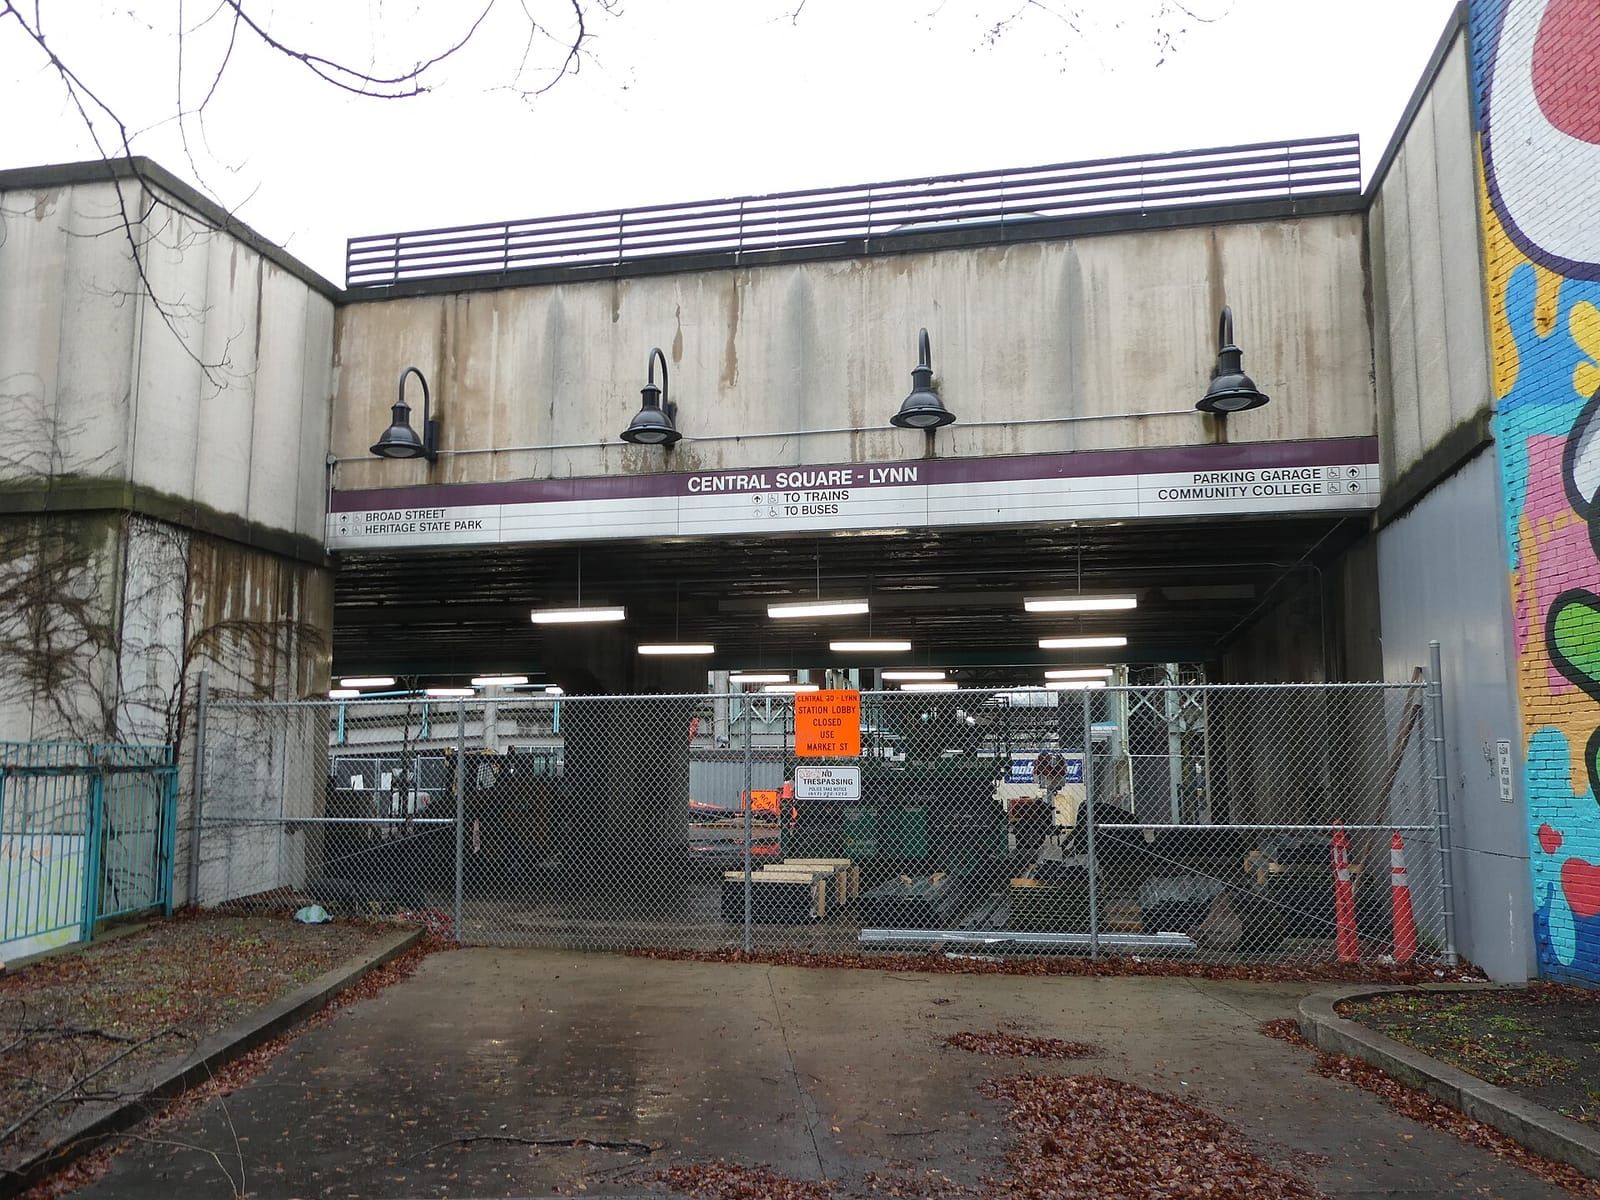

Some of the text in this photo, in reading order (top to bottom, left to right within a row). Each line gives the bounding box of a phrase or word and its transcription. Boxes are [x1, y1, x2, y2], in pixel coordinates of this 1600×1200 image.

[687, 473, 771, 492] CENTRAL
[775, 470, 853, 488] SQUARE
[869, 467, 918, 484] LYNN
[1193, 468, 1321, 484] PARKING GARAGE
[783, 490, 850, 503] TO TRAINS
[1158, 483, 1322, 500] COMMUNITY COLLEGE
[365, 509, 446, 522] BROAD STREET
[783, 504, 839, 516] TO BUSES
[365, 520, 482, 534] HERITAGE STATE PARK
[841, 694, 858, 702] LYNN
[798, 705, 857, 714] STATION LOBBY
[812, 718, 842, 727] CLOSED
[820, 731, 835, 739] USE
[806, 742, 849, 751] MARKET ST
